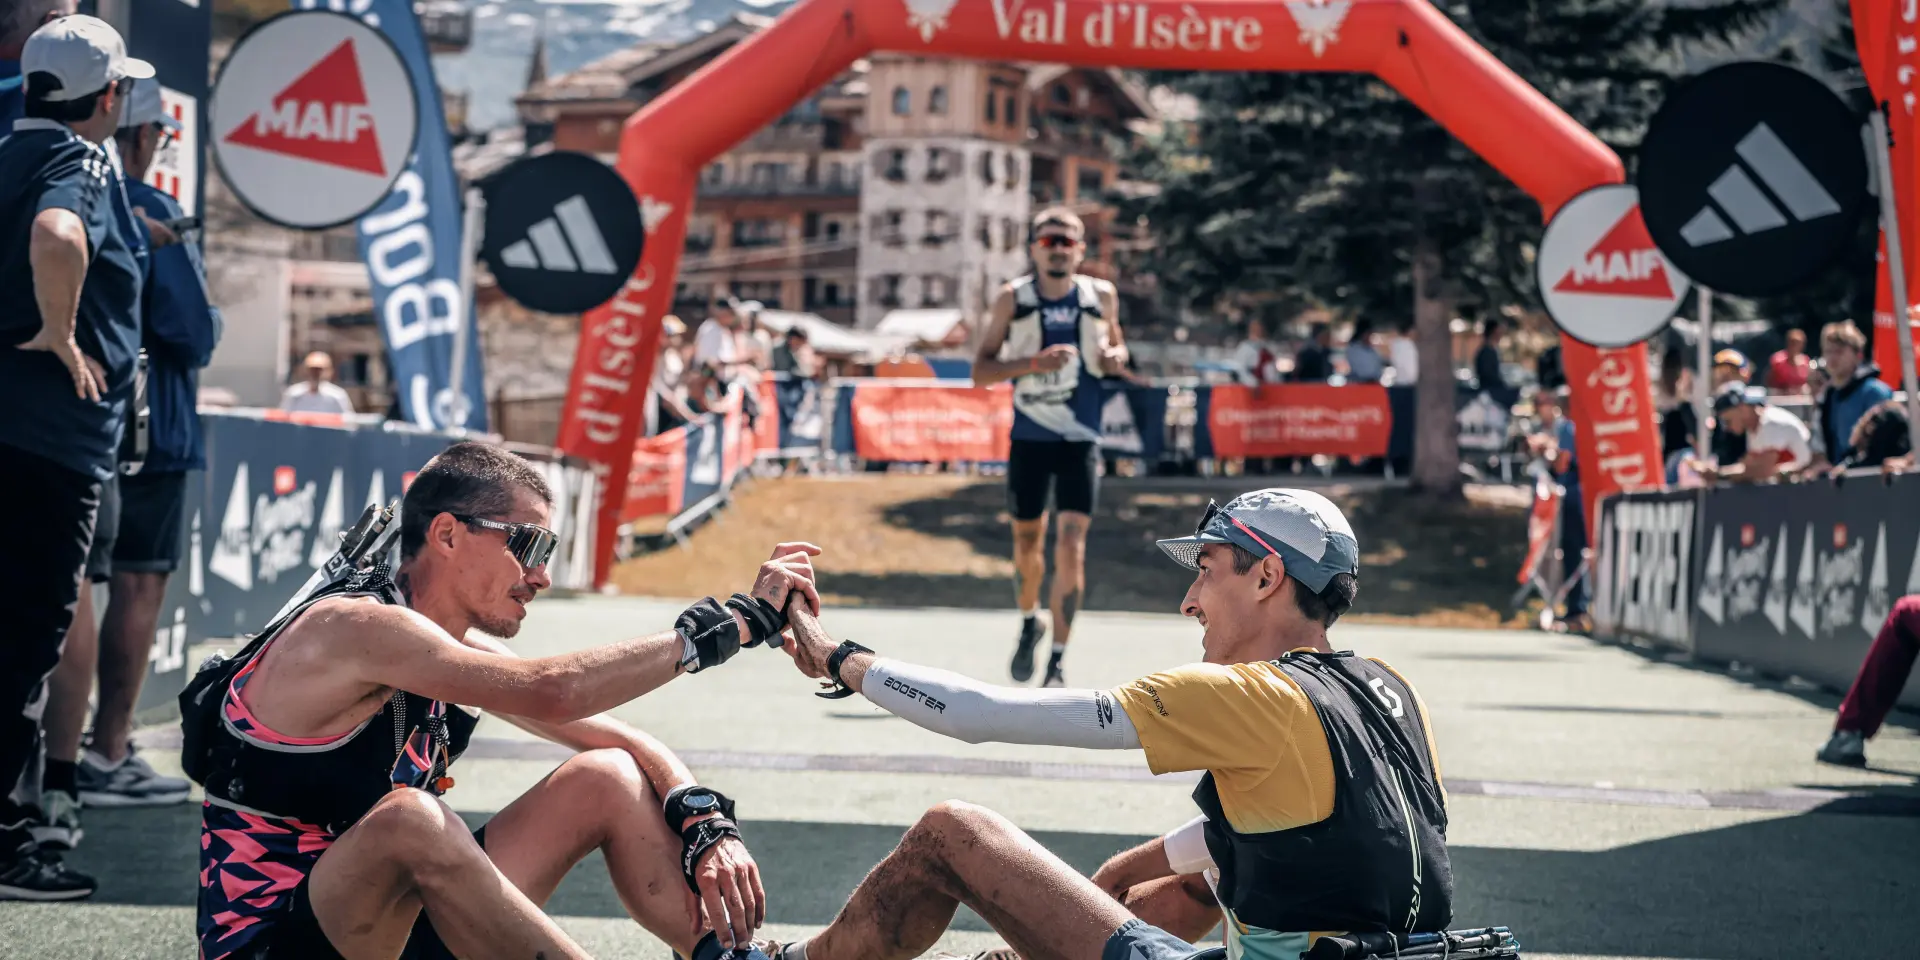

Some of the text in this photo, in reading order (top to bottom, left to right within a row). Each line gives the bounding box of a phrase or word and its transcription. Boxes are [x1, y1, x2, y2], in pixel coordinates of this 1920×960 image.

[991, 0, 1263, 52] Val d'Isère
[254, 98, 373, 143] MAIF
[1573, 249, 1660, 285] MAIF
[1586, 347, 1648, 486] d'Isè
[883, 676, 946, 715] BOOSTER
[1095, 698, 1105, 730] SPORT
